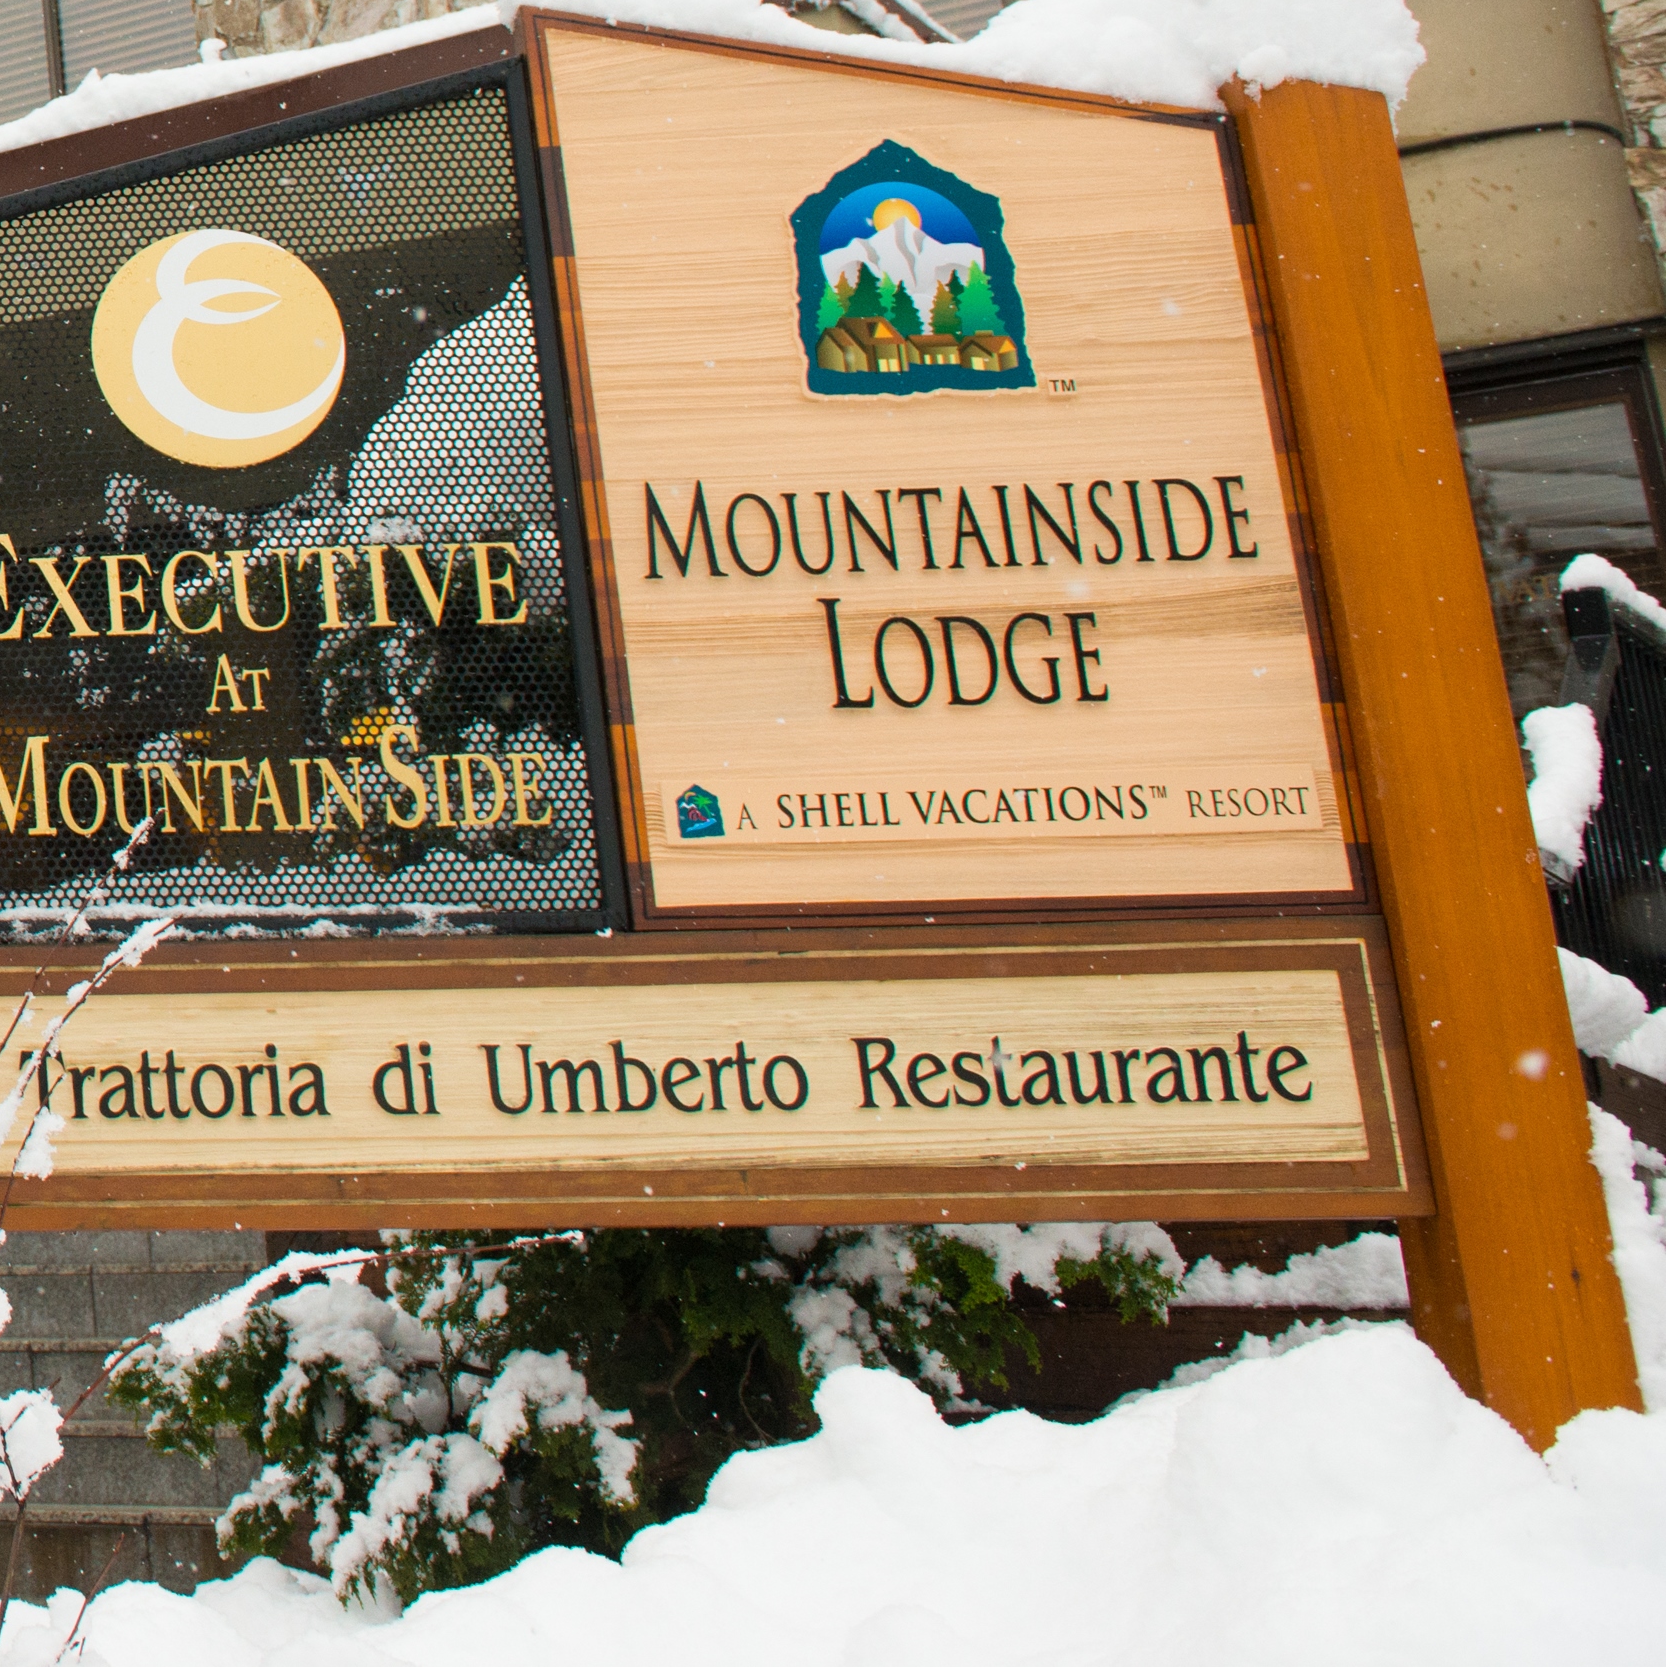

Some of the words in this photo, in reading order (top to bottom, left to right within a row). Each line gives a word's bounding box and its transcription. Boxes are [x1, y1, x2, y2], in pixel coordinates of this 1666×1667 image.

[643, 474, 1259, 580] MOUNTAINSIDE
[205, 652, 271, 713] AT
[816, 597, 1110, 710] LODGE
[736, 802, 759, 831] A
[776, 791, 902, 828] SHELL
[1184, 786, 1309, 819] RESORT
[18, 1043, 331, 1121] Trattoria
[371, 1040, 441, 1117] di
[478, 1038, 809, 1116] Umberto
[849, 1029, 1313, 1110] Restaurante
